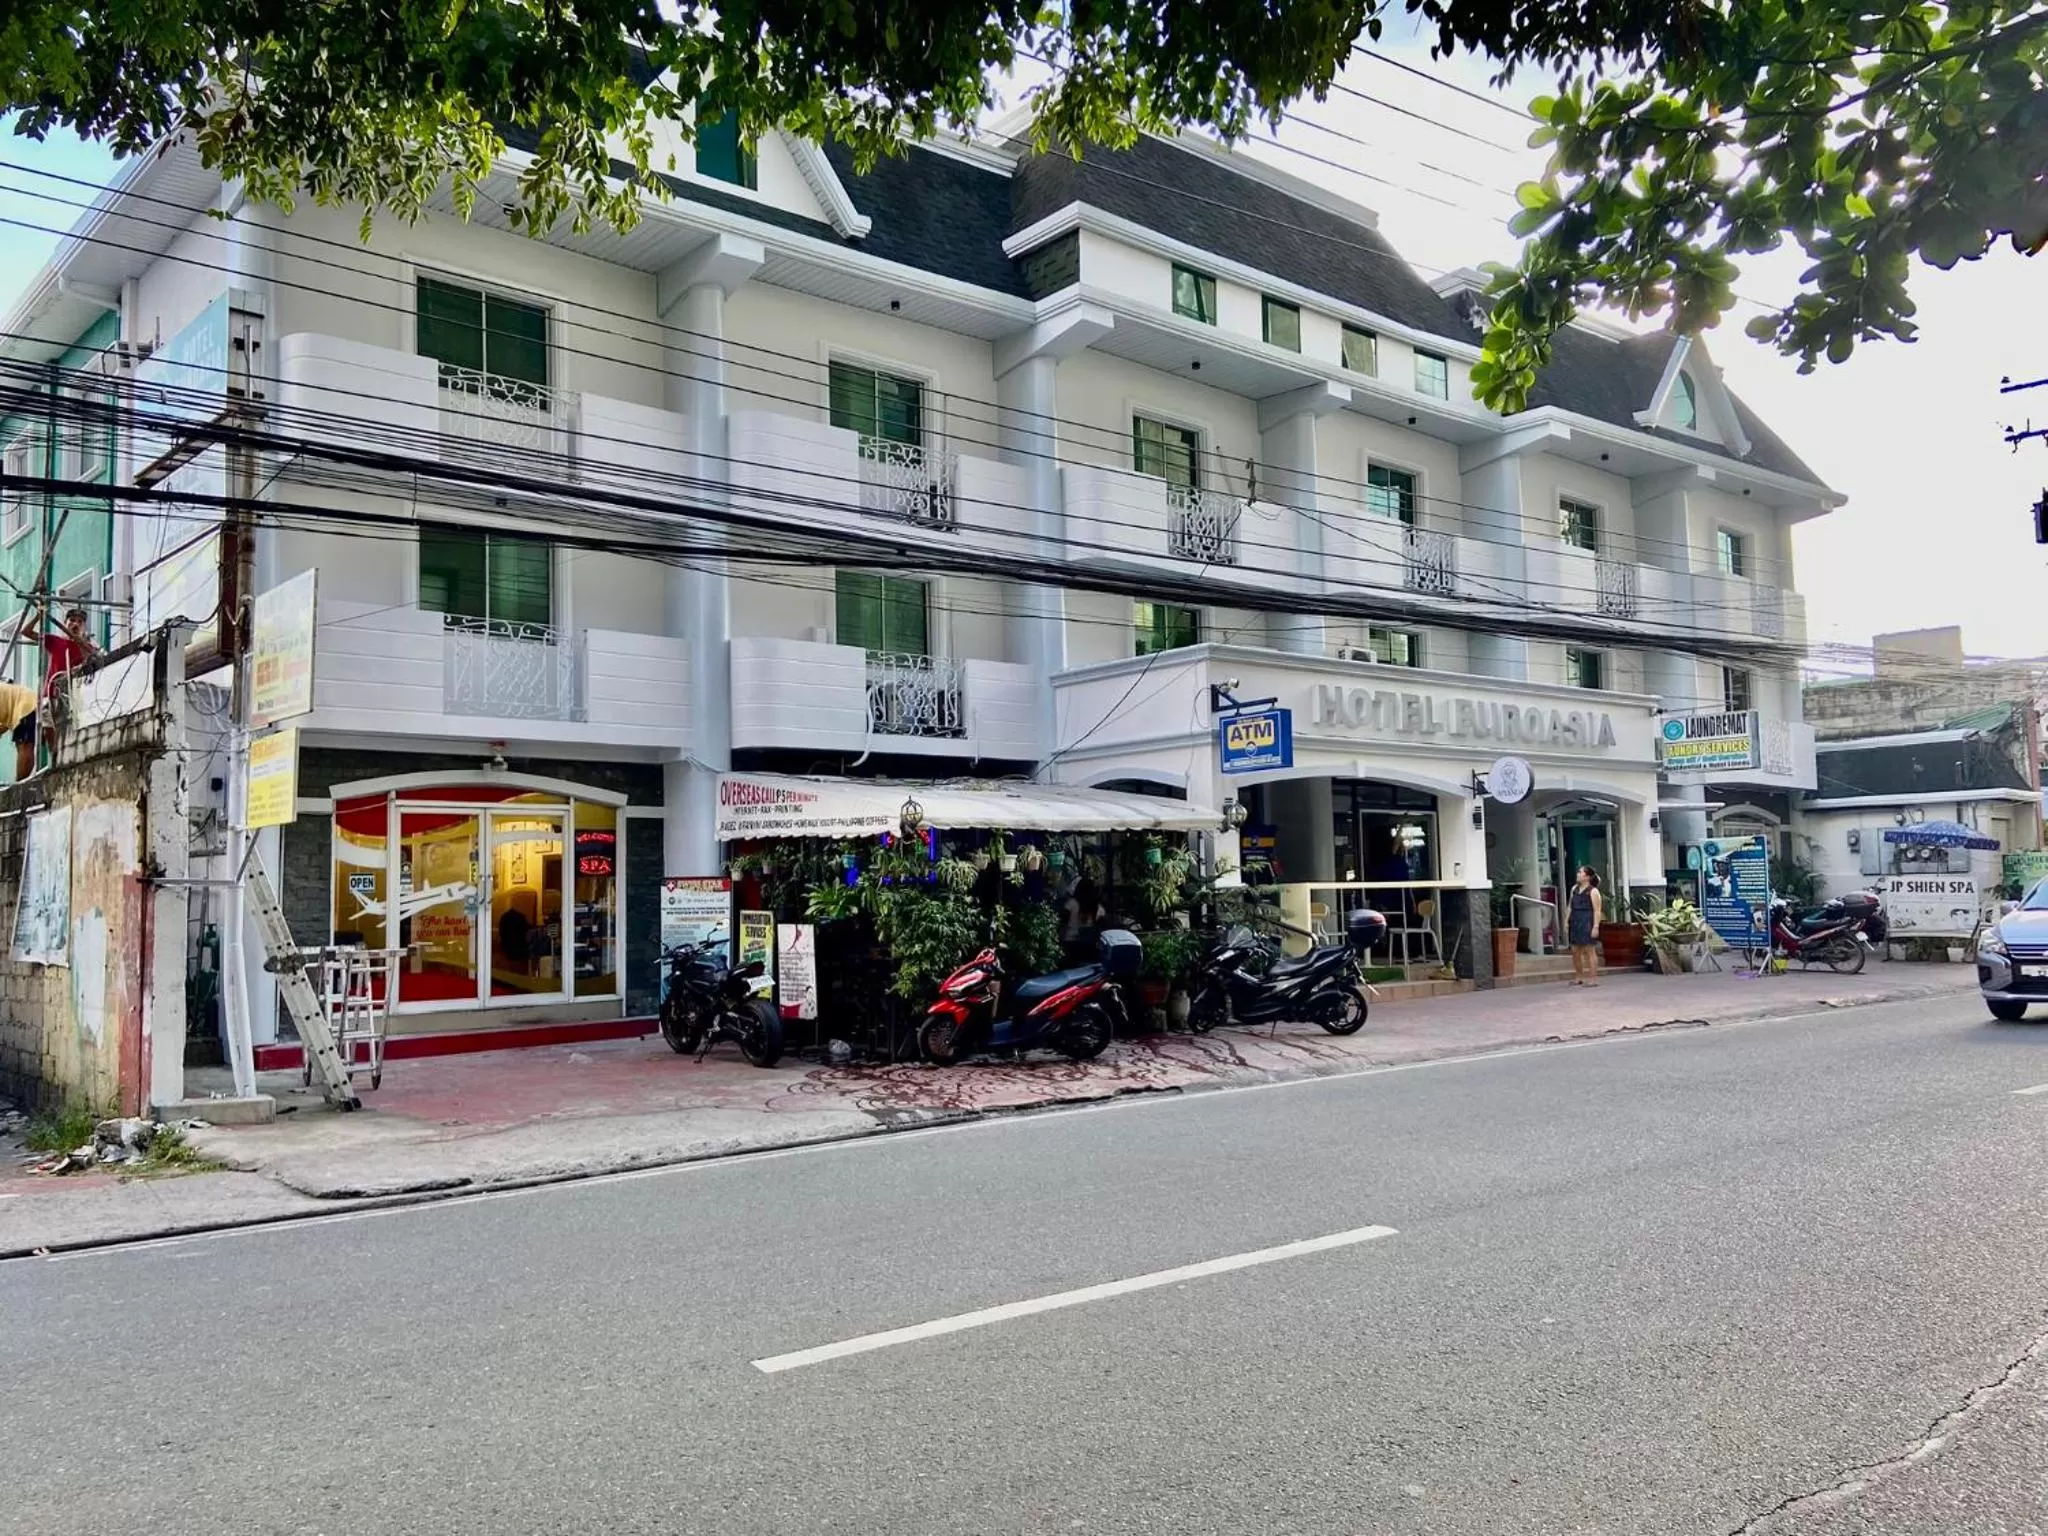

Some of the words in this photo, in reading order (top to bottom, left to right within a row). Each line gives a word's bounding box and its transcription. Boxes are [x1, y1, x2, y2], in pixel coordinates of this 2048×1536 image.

[1312, 684, 1443, 735] HOTEL
[1448, 698, 1617, 749] EUROASIA
[1685, 712, 1747, 738] LAUNDREMAT
[1230, 722, 1272, 743] ATM
[1704, 739, 1750, 755] SERVICES
[720, 780, 760, 806] OVERSEAS
[761, 785, 776, 804] CALL
[580, 860, 611, 871] SPA
[350, 877, 374, 889] OPEN
[1890, 881, 1903, 893] JP
[1907, 881, 1945, 894] SHIEN
[1949, 881, 1975, 894] SPA
